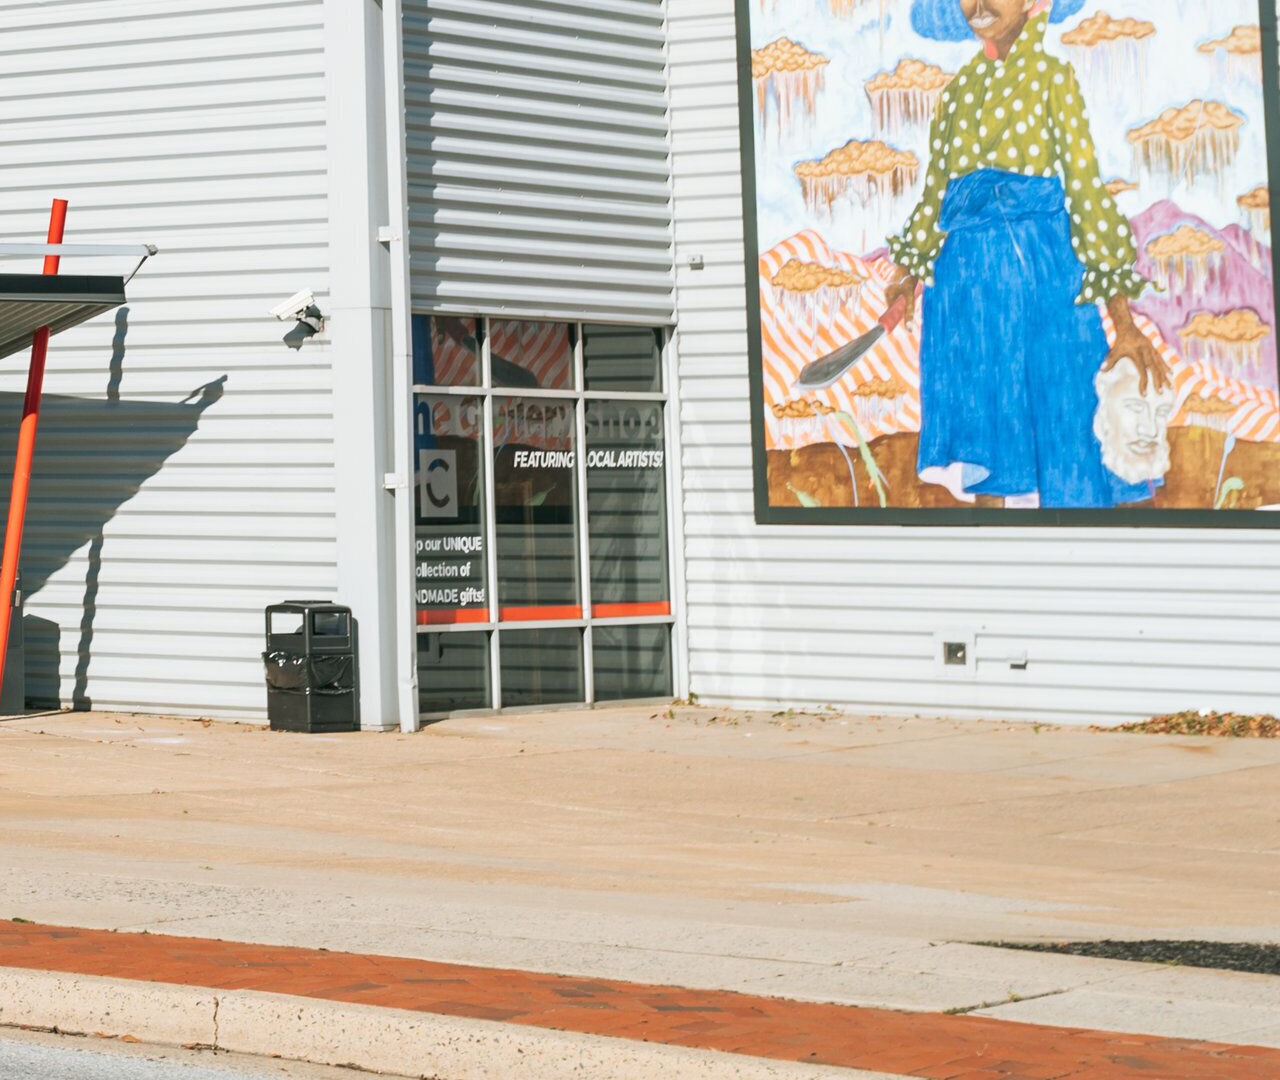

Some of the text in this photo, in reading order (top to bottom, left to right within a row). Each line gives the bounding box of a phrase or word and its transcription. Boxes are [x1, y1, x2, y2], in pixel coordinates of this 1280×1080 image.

[413, 394, 451, 438] he
[513, 450, 663, 468] FEATURING OCAL ARTISTS!
[426, 458, 450, 508] C
[425, 540, 441, 551] our
[443, 536, 482, 553] UNIQUE
[415, 561, 471, 577] ollection of
[414, 587, 485, 606] NDMADE gifts!
